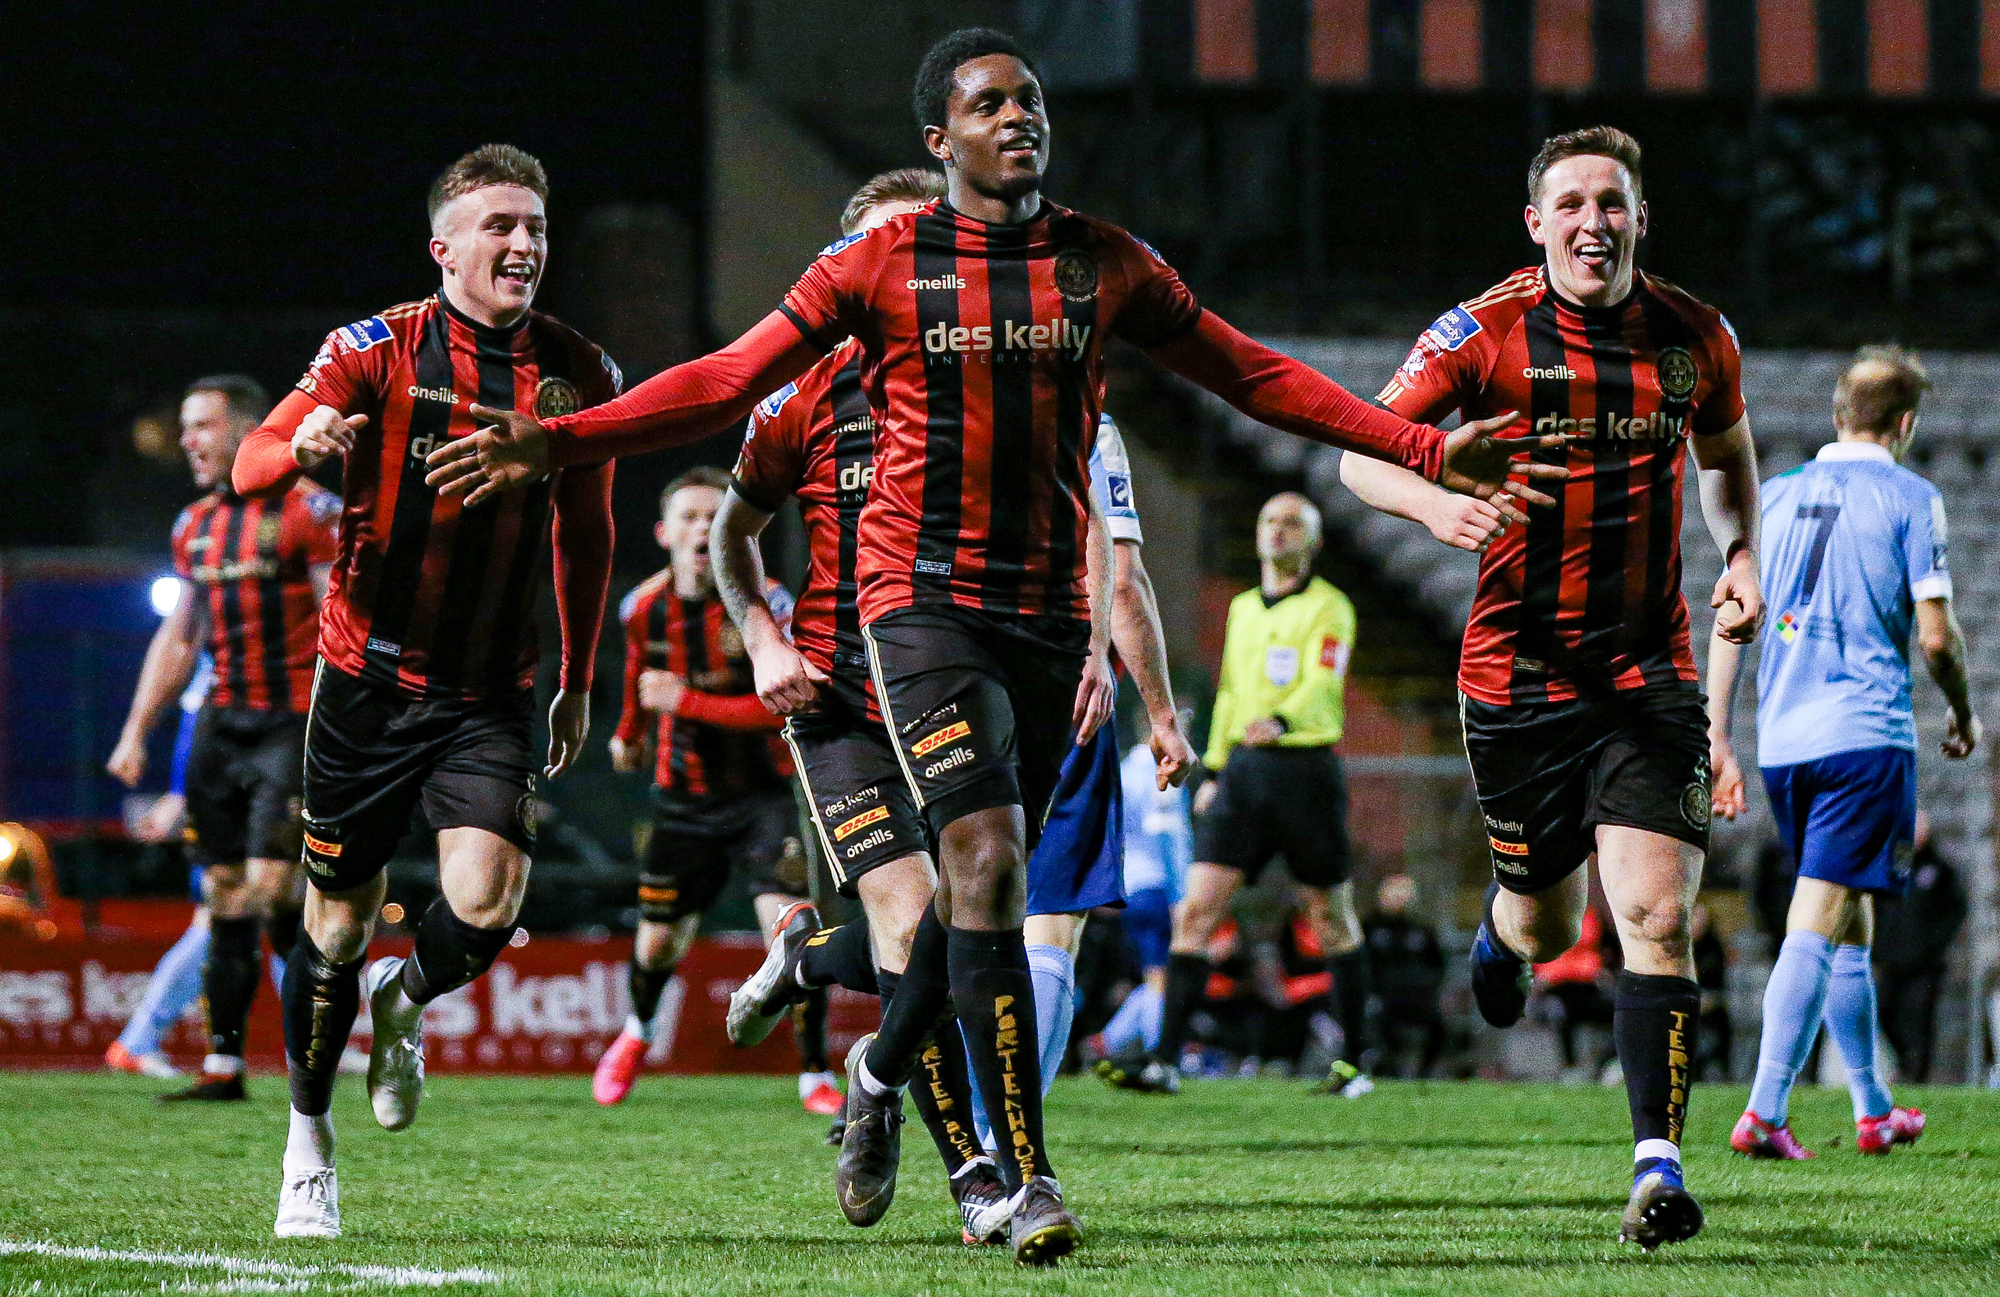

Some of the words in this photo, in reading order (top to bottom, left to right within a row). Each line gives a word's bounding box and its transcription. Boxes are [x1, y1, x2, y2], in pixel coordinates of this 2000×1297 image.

[925, 321, 993, 353] des
[1004, 318, 1091, 362] kelly
[1536, 411, 1597, 439] des
[1607, 411, 1684, 447] kelly
[840, 461, 877, 491] de
[1797, 504, 1841, 606] 7
[917, 725, 963, 754] DHL
[825, 800, 846, 818] des
[839, 809, 882, 836] DHL
[1498, 819, 1523, 836] kelly
